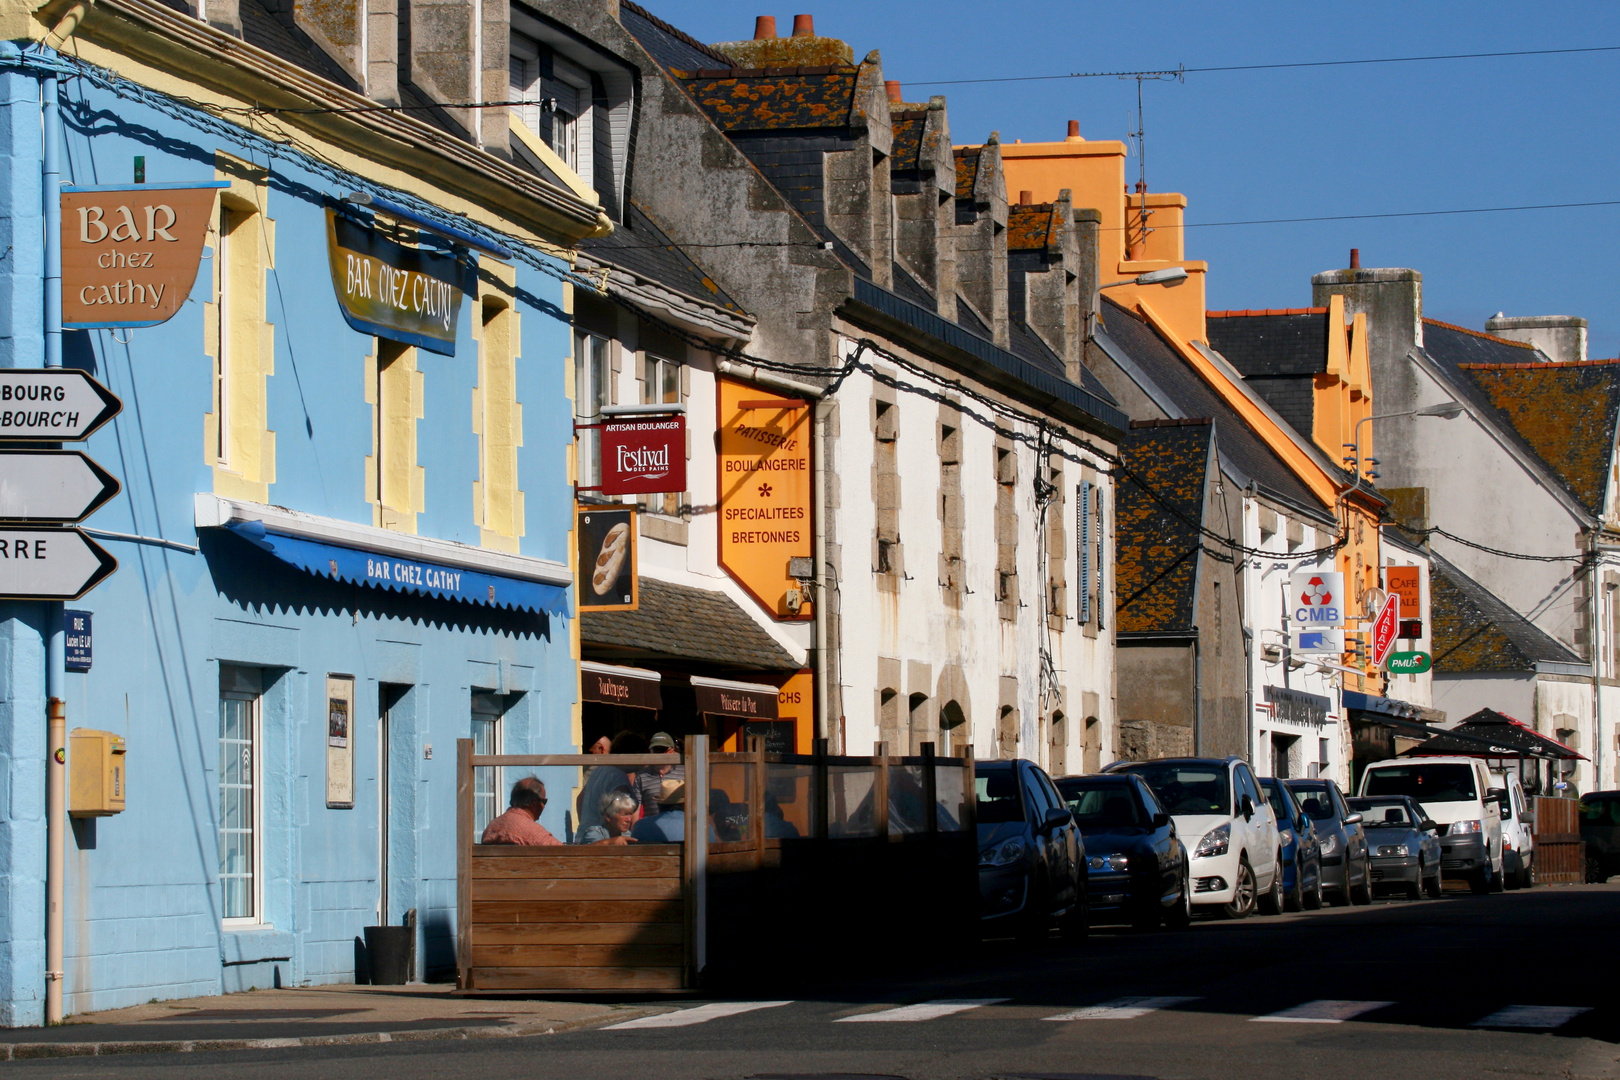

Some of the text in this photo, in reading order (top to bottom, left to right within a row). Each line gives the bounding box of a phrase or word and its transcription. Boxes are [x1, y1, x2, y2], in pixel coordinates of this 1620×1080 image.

[77, 204, 178, 243] BAR
[98, 249, 154, 269] chez
[347, 254, 372, 300] BAR
[79, 279, 165, 309] cathy
[0, 385, 65, 401] BOURG
[606, 421, 679, 432] ARTISAN BOULANGER
[735, 423, 798, 452] PATISSERIE
[616, 443, 669, 473] Festival
[725, 458, 806, 472] BOULANGERIE
[725, 507, 804, 520] SPECIALITEES
[732, 530, 800, 544] BRETONNES
[367, 558, 461, 592] BAR CHEZ CATHY
[1390, 576, 1418, 590] CAFÉ
[1400, 598, 1418, 607] ALE
[1295, 607, 1339, 622] CMB
[74, 617, 84, 630] RUE
[1376, 607, 1394, 652] TABAC
[1391, 659, 1412, 668] PMU
